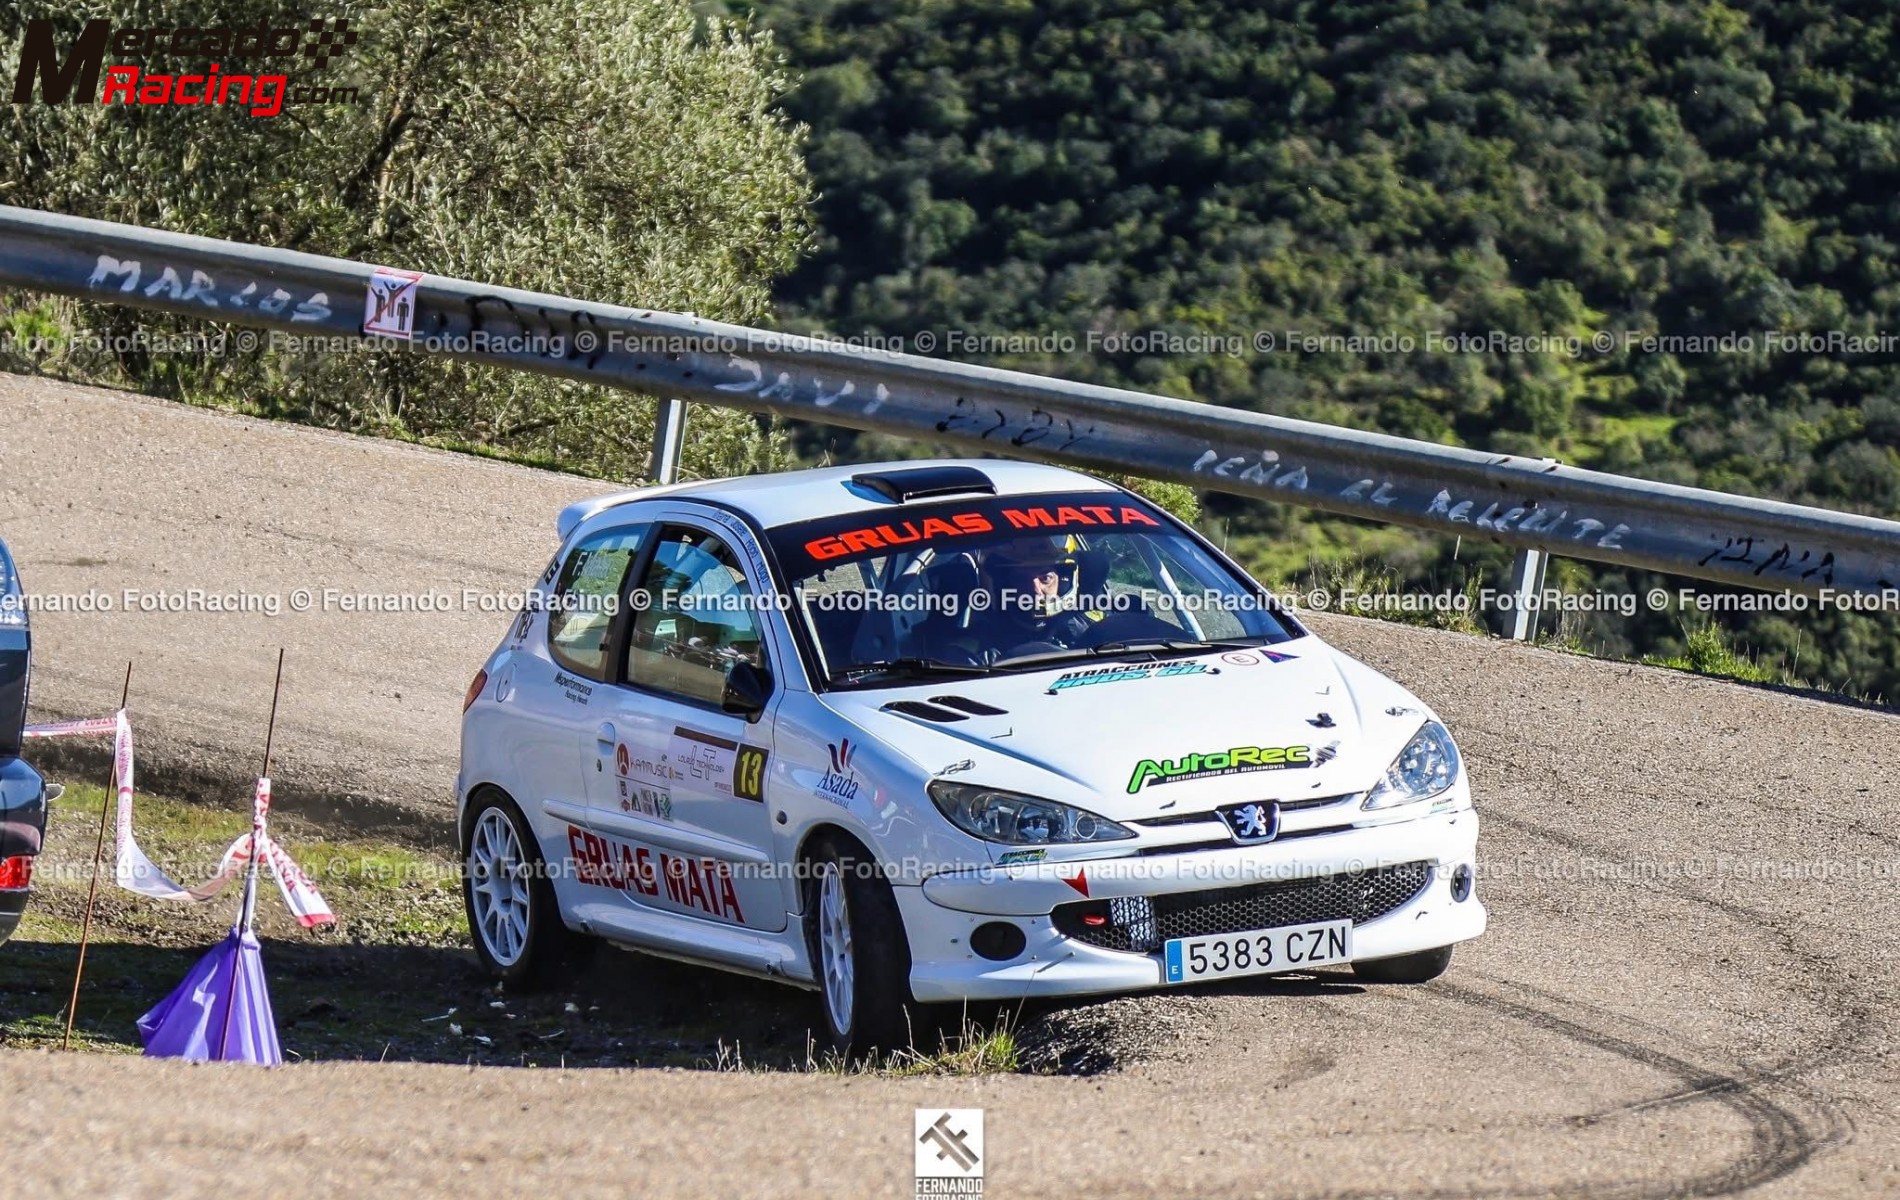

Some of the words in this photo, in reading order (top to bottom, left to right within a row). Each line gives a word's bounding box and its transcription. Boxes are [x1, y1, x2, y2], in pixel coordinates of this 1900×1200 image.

[804, 513, 994, 561] GRUAS
[1002, 505, 1161, 529] MATA
[1059, 659, 1199, 682] ATRACCIONES
[741, 751, 763, 796] 13
[817, 765, 860, 800] Asada
[1126, 745, 1311, 795] AutoRec
[567, 824, 660, 897] GRUAS
[659, 852, 746, 925] MATA
[1171, 965, 1179, 974] E
[1189, 935, 1273, 975] 5383
[1286, 926, 1347, 963] CZN
